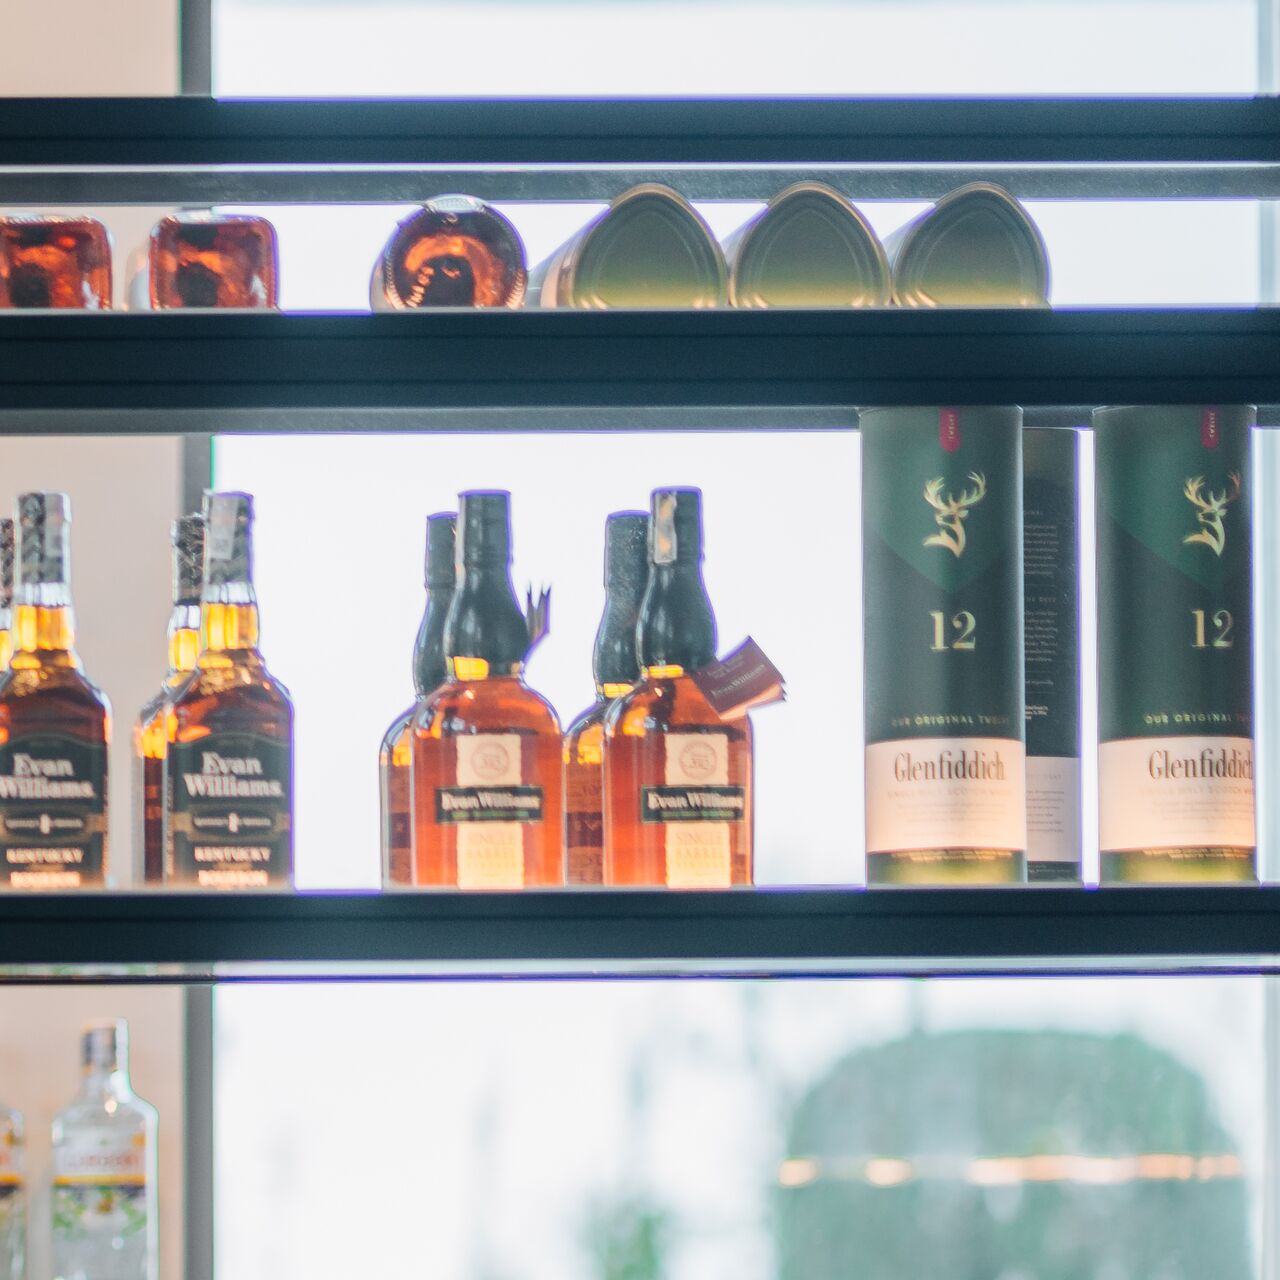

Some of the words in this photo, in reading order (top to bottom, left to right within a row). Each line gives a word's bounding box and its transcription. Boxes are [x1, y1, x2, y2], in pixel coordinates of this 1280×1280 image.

[928, 609, 978, 652] 12
[1190, 608, 1235, 650] 12
[914, 714, 974, 727] ORIGINAL
[1143, 714, 1169, 726] OUR
[1174, 712, 1232, 725] ORIGINAL
[12, 753, 74, 777] Evan
[201, 752, 263, 776] Evan
[893, 749, 1007, 781] Glenfiddich
[183, 775, 285, 798] Williams
[441, 792, 480, 811] Evan
[478, 792, 540, 812] Williams
[647, 791, 687, 810] Evan
[685, 791, 743, 811] Williams
